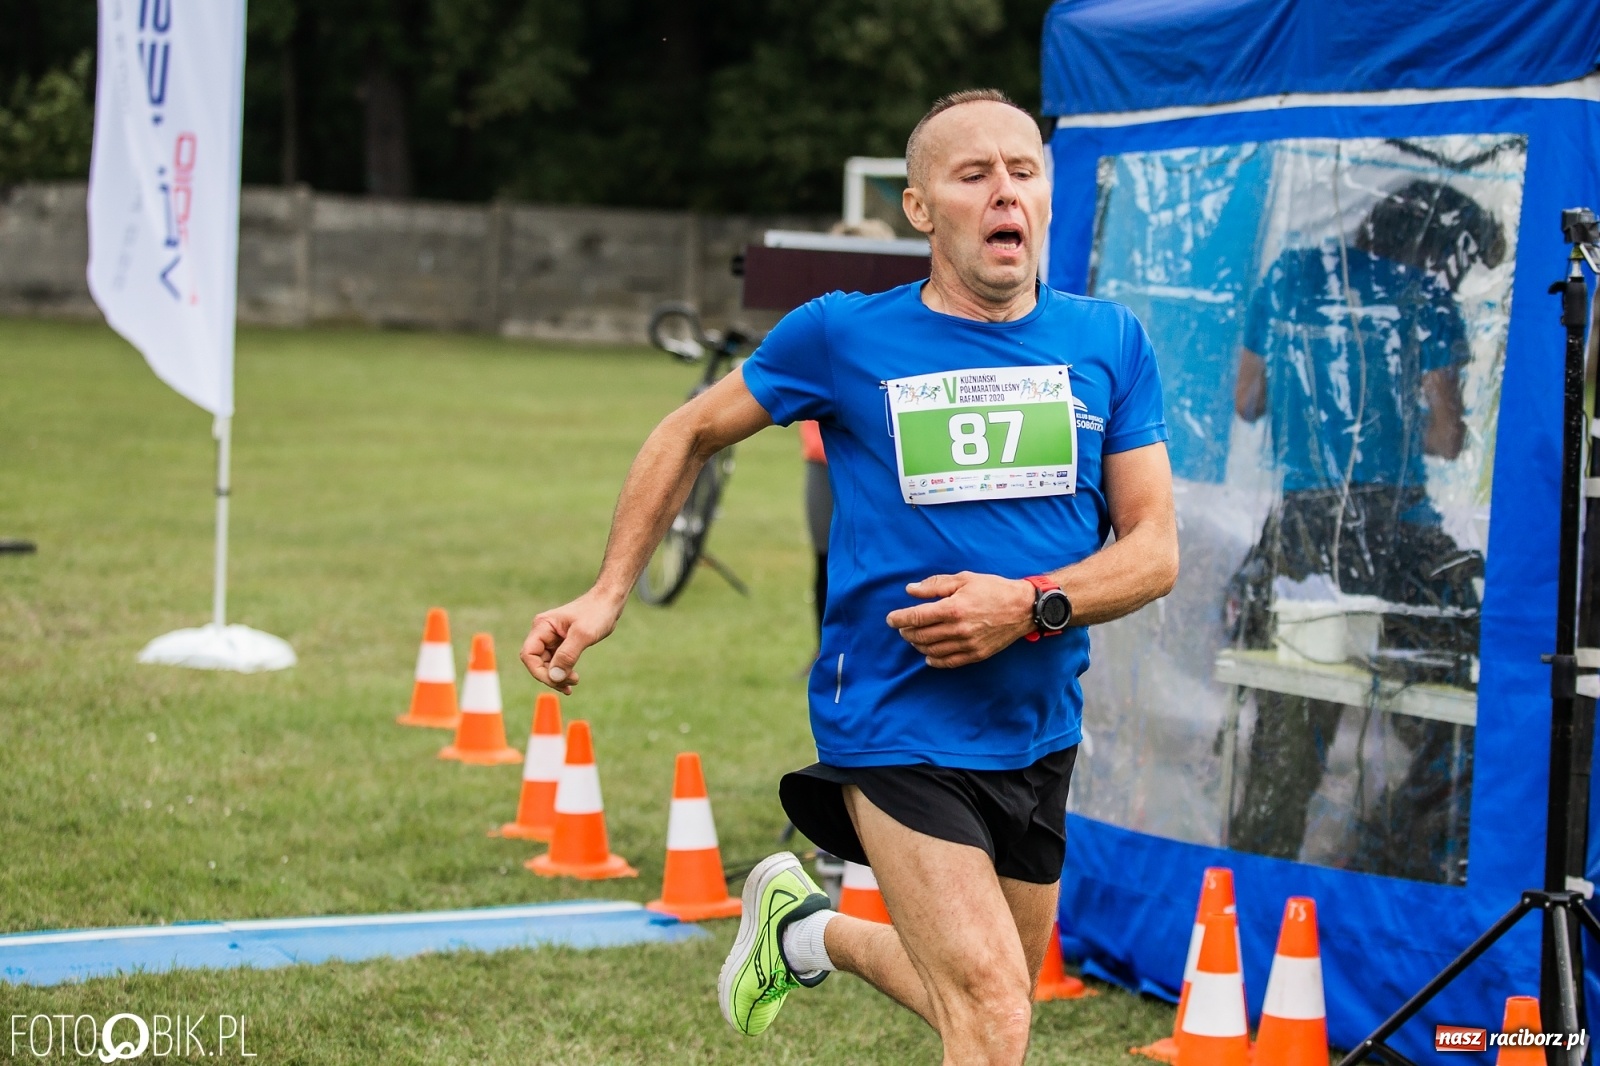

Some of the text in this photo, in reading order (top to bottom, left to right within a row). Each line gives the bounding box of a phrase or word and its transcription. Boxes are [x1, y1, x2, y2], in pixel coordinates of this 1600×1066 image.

[942, 377, 957, 404] V
[959, 393, 1005, 404] RAFAMET 2020
[948, 409, 1025, 466] 87
